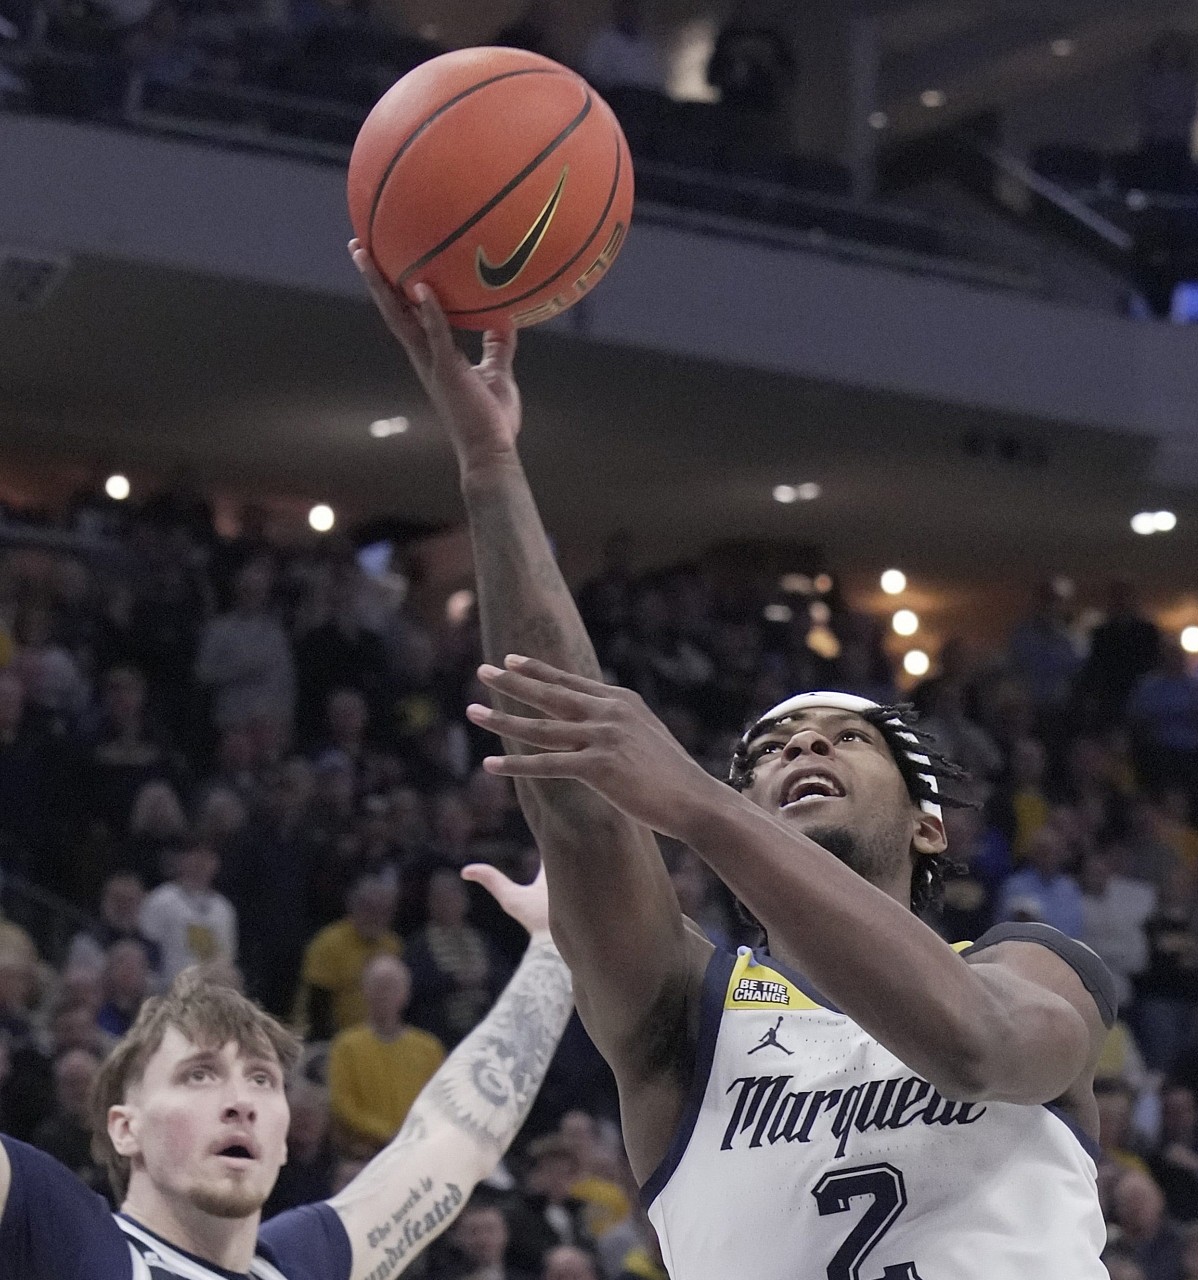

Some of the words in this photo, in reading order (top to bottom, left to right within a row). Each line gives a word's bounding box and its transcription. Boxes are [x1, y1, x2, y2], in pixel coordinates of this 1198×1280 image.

[739, 979, 758, 991] BE
[761, 981, 788, 995] THE
[733, 988, 790, 1005] CHANGE
